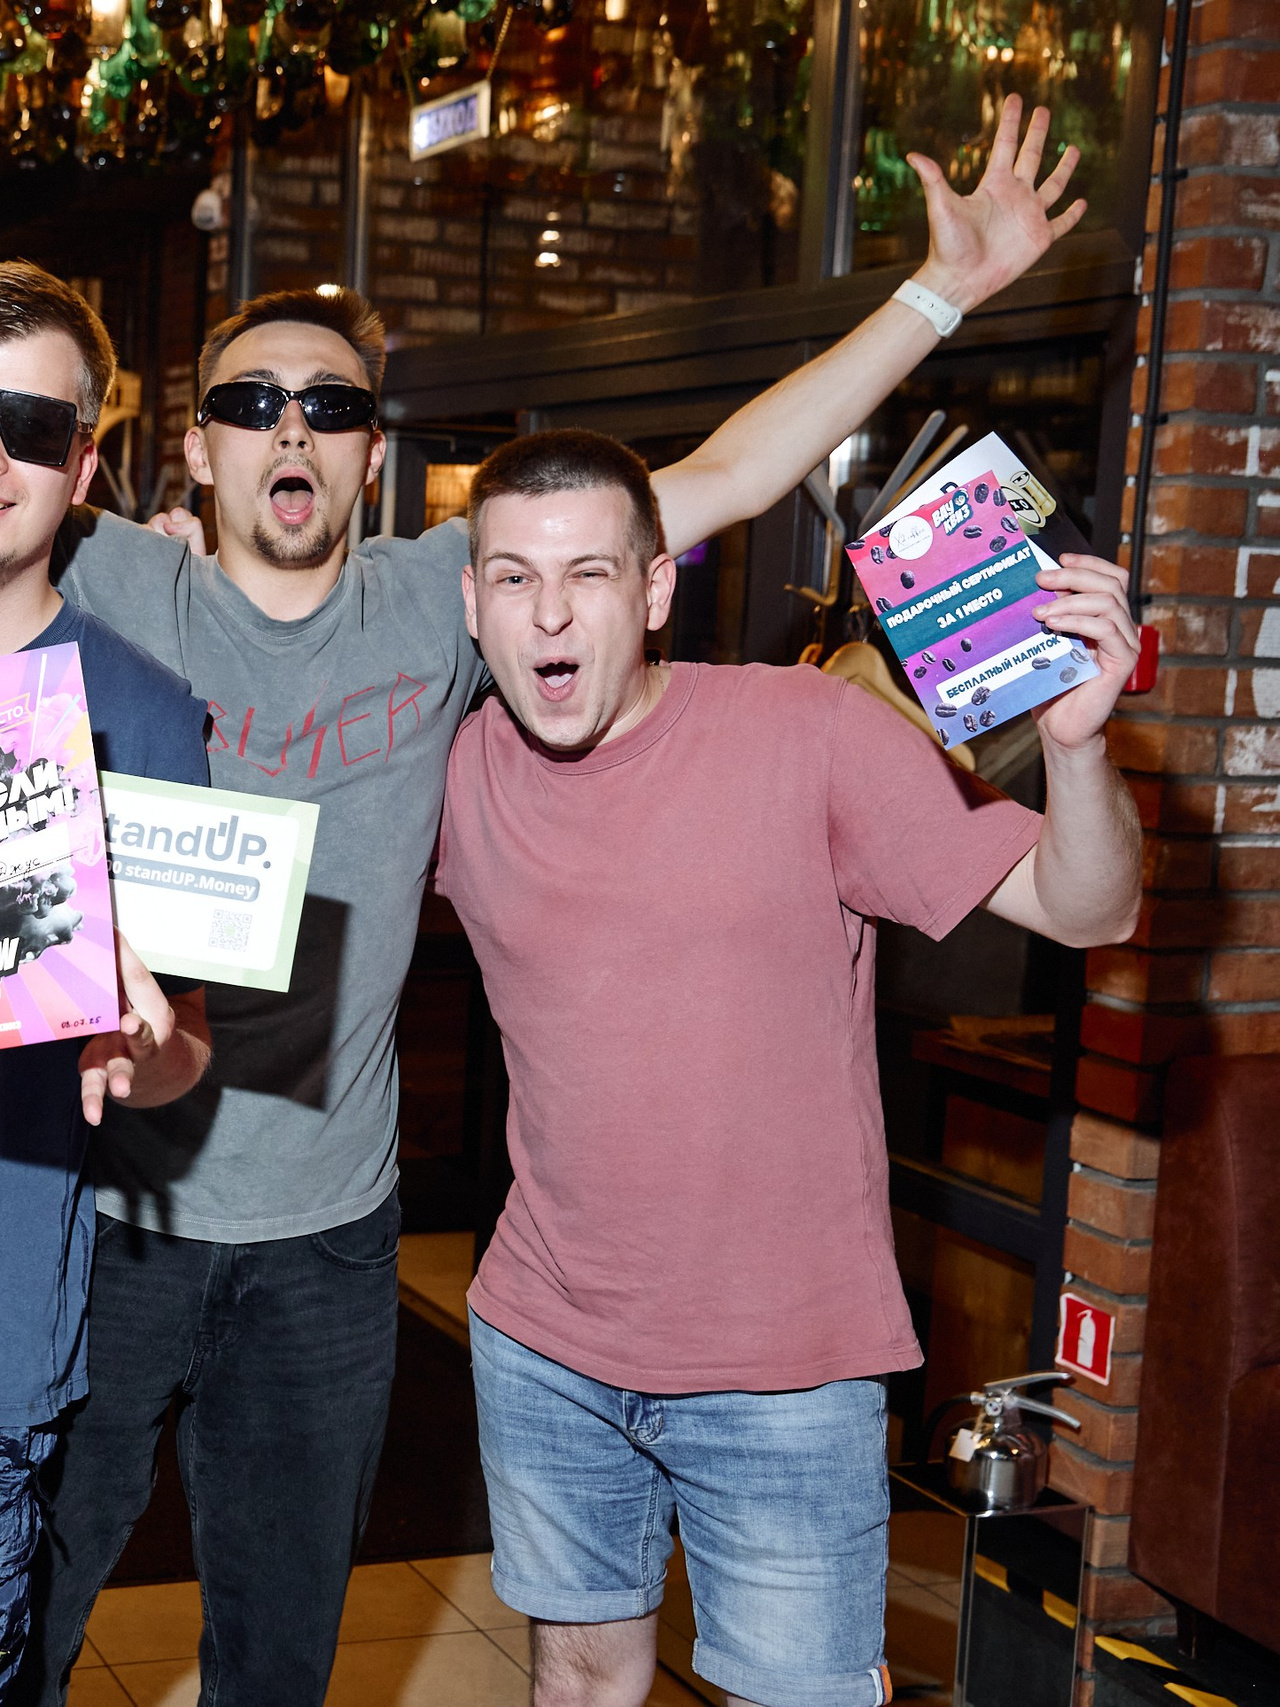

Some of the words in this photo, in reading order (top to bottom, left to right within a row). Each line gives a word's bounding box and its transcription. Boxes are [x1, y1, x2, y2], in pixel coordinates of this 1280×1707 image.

[886, 580, 963, 629] ПОДАРОЧНЫЙ
[961, 547, 1032, 590] СЕРТИФИКАТ
[936, 612, 957, 629] ЗА
[955, 607, 965, 620] 1
[961, 587, 1003, 615] МЕСТО
[946, 658, 1013, 699] БЕСПЛАТНЫЙ
[1012, 635, 1061, 665] НАПИТОК
[104, 812, 272, 869] tandUP.
[124, 862, 256, 900] standUP.Money
